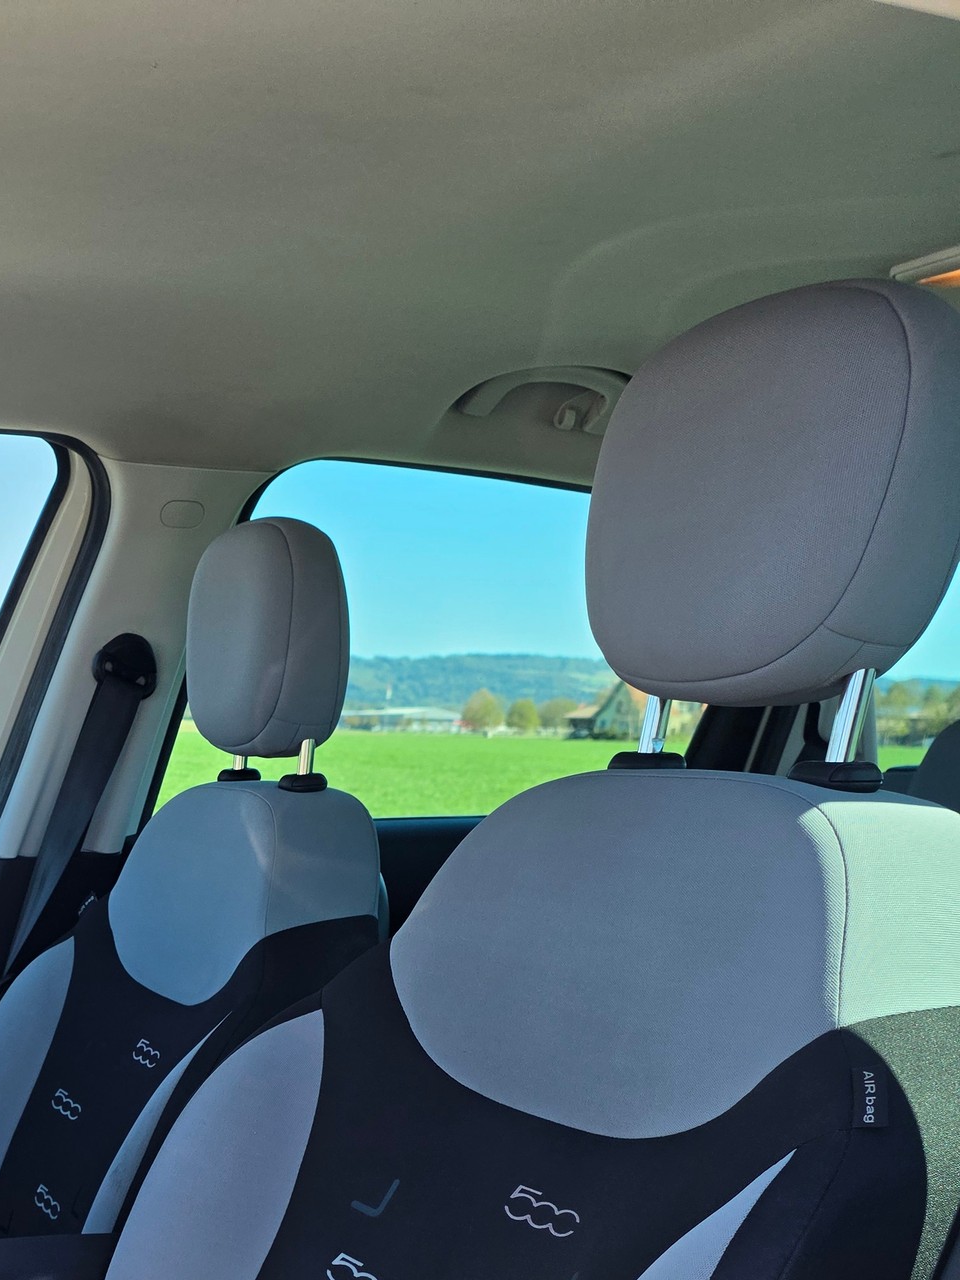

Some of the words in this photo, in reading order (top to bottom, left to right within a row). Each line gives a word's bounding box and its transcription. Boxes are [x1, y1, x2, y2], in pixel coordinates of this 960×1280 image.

[132, 1039, 160, 1068] 500
[862, 1070, 877, 1095] AIR
[52, 1088, 82, 1120] 500
[862, 1096, 877, 1124] bag
[35, 1184, 60, 1220] 500
[504, 1185, 580, 1238] 500
